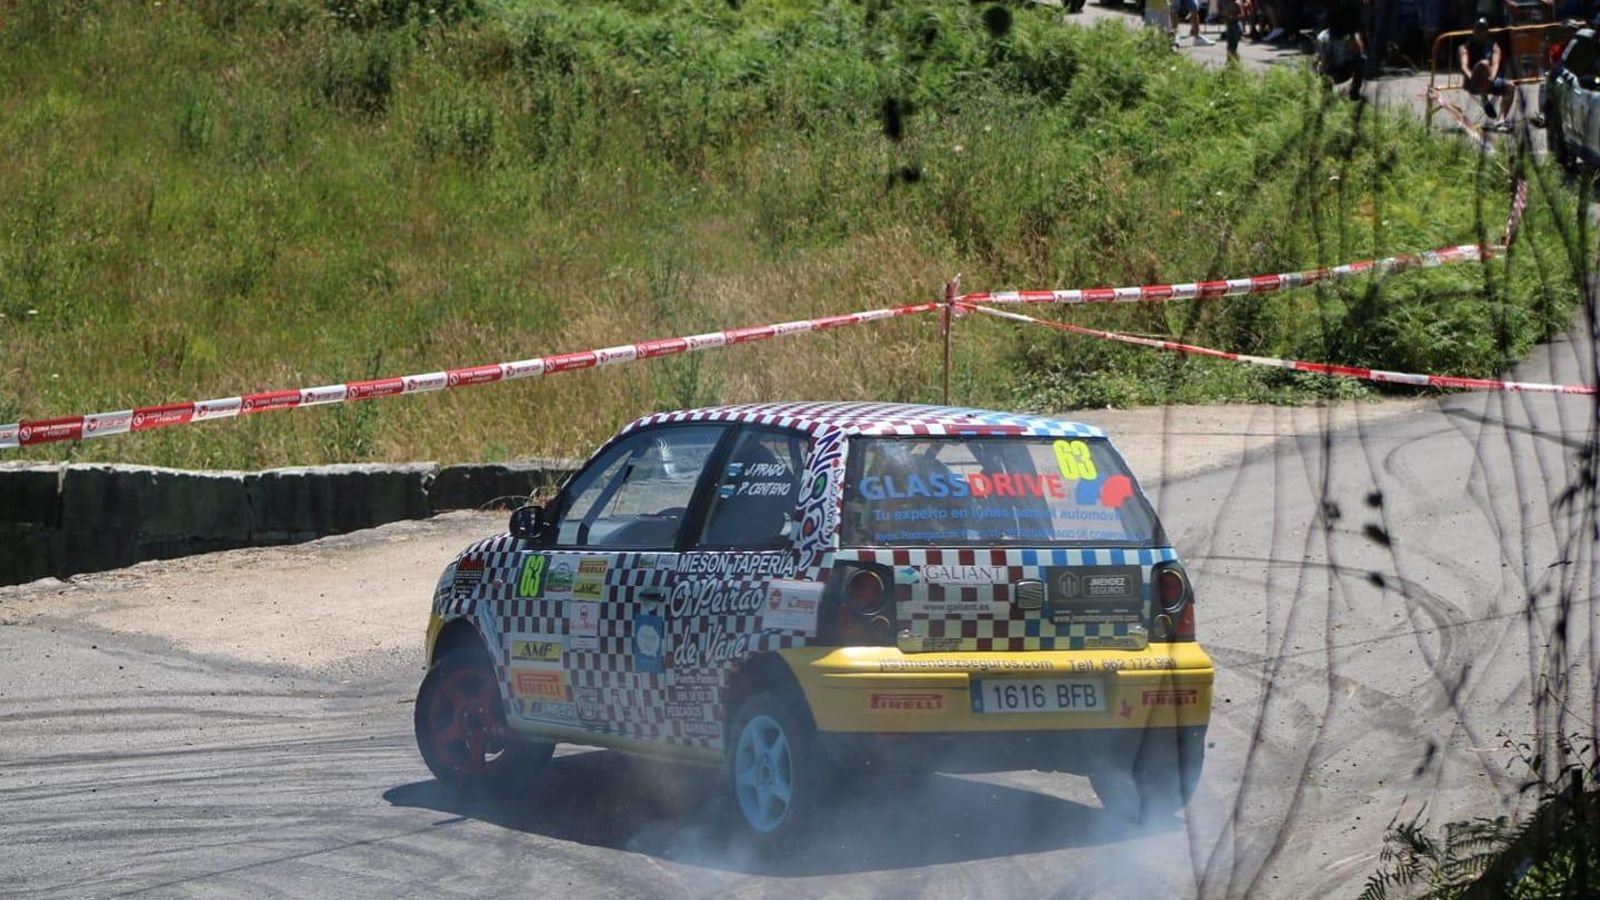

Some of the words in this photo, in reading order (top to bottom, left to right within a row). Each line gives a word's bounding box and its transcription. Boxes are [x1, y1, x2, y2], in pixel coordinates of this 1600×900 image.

[1053, 439, 1097, 480] 63
[858, 472, 1067, 500] GLASSDRIVE
[874, 509, 890, 520] Tu
[895, 507, 948, 522] experto
[951, 508, 967, 518] en
[519, 555, 545, 598] 63
[925, 565, 1004, 580] GALIANT
[521, 642, 553, 657] AMF
[870, 693, 943, 709] PIRELLI
[993, 684, 1046, 709] 1616
[1056, 684, 1097, 708] BFB
